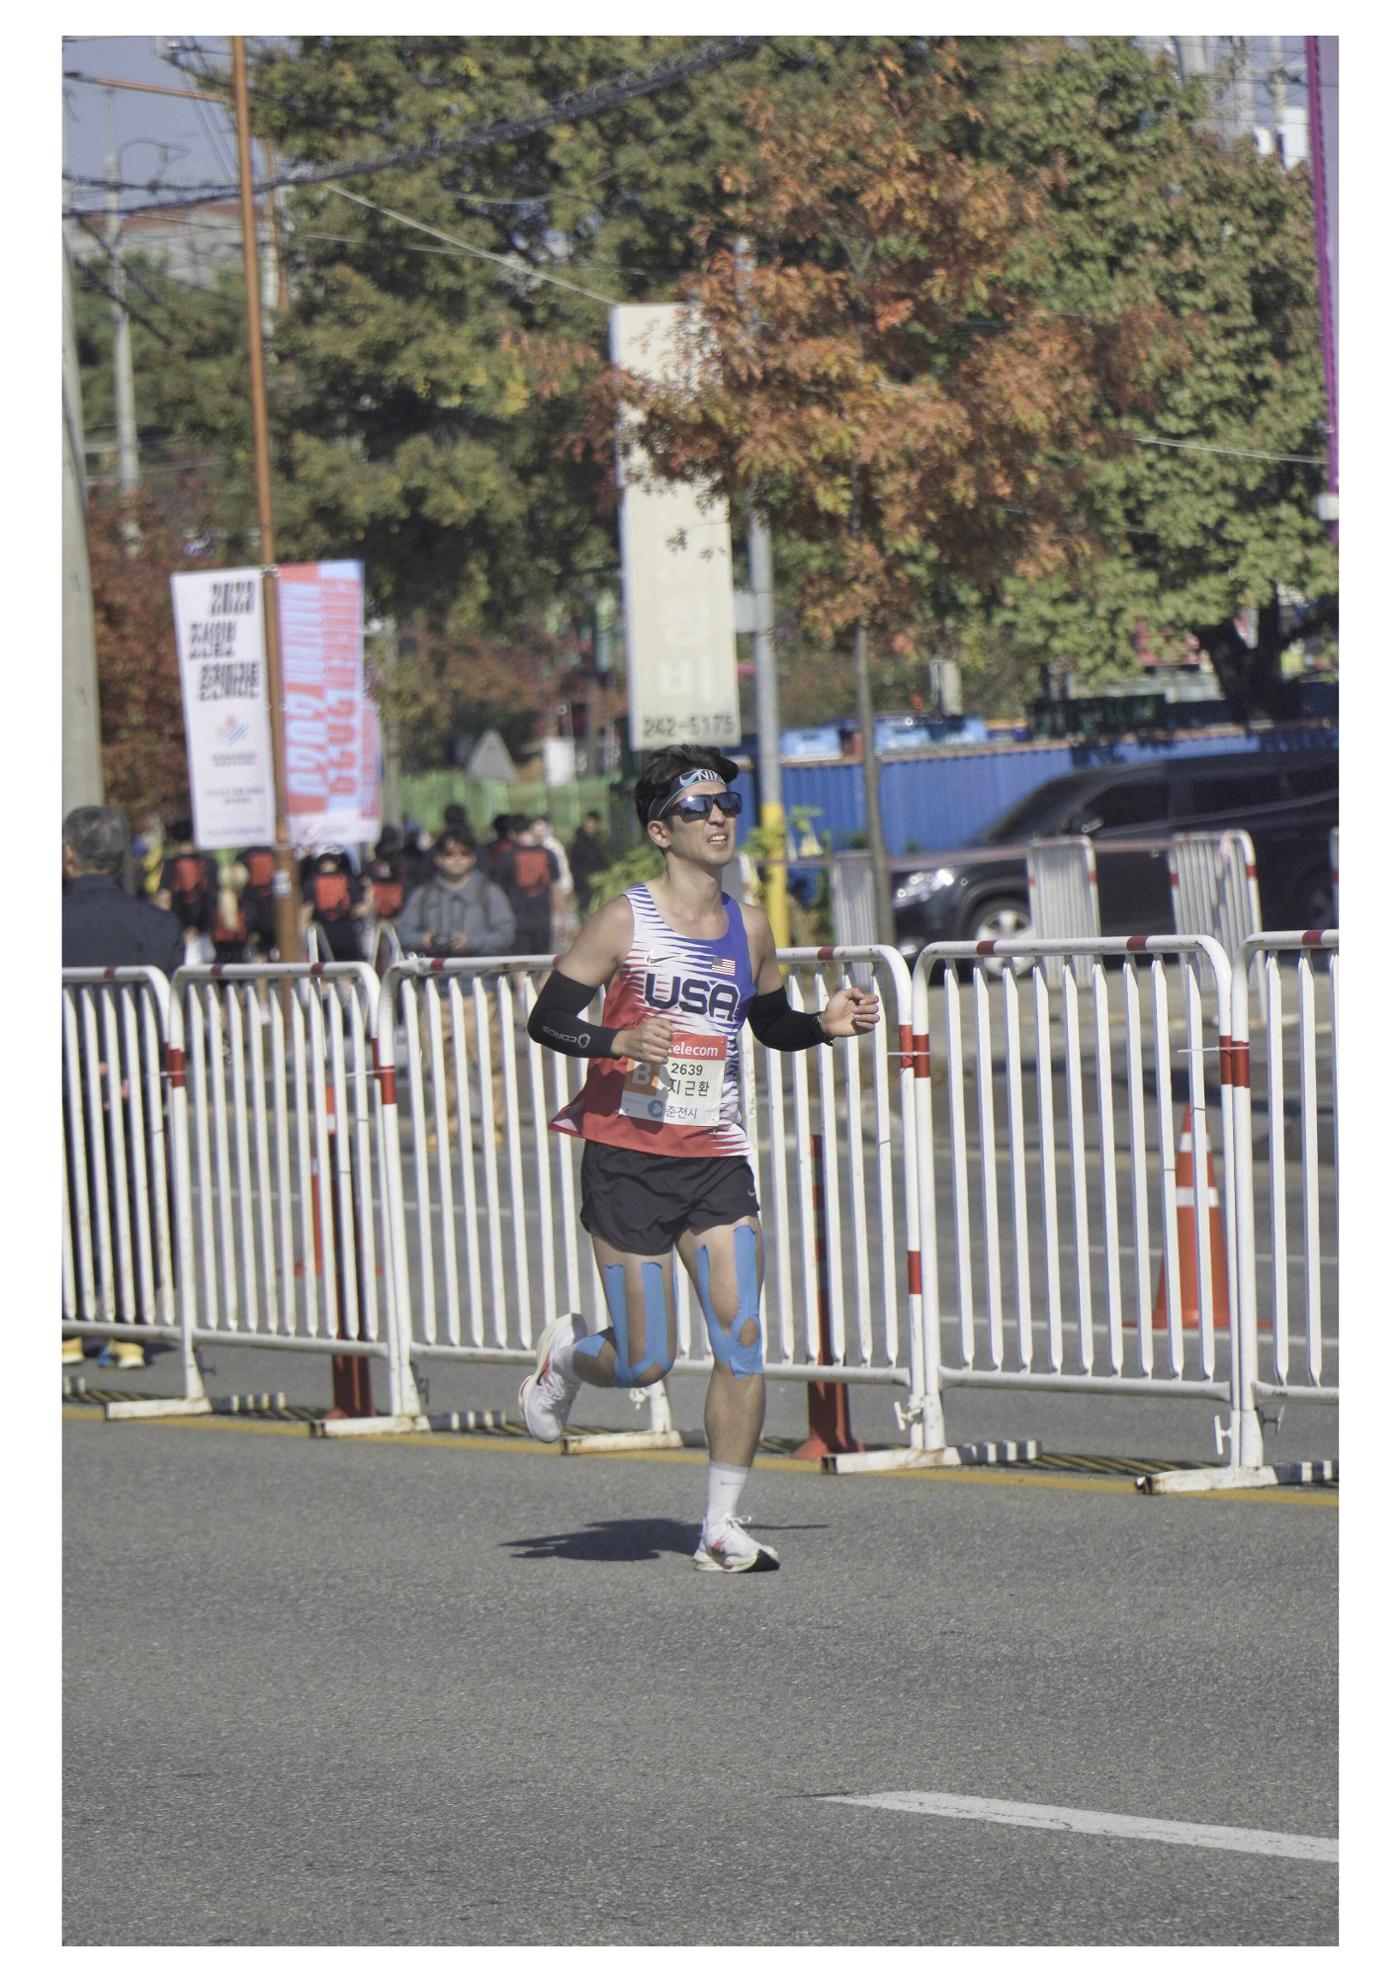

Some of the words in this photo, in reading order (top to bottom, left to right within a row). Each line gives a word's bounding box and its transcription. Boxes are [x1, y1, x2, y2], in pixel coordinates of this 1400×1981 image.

[643, 711, 736, 738] 242-5175
[697, 769, 721, 781] NIK
[644, 973, 741, 1021] USA
[632, 1061, 651, 1086] B
[671, 1062, 703, 1076] 2639
